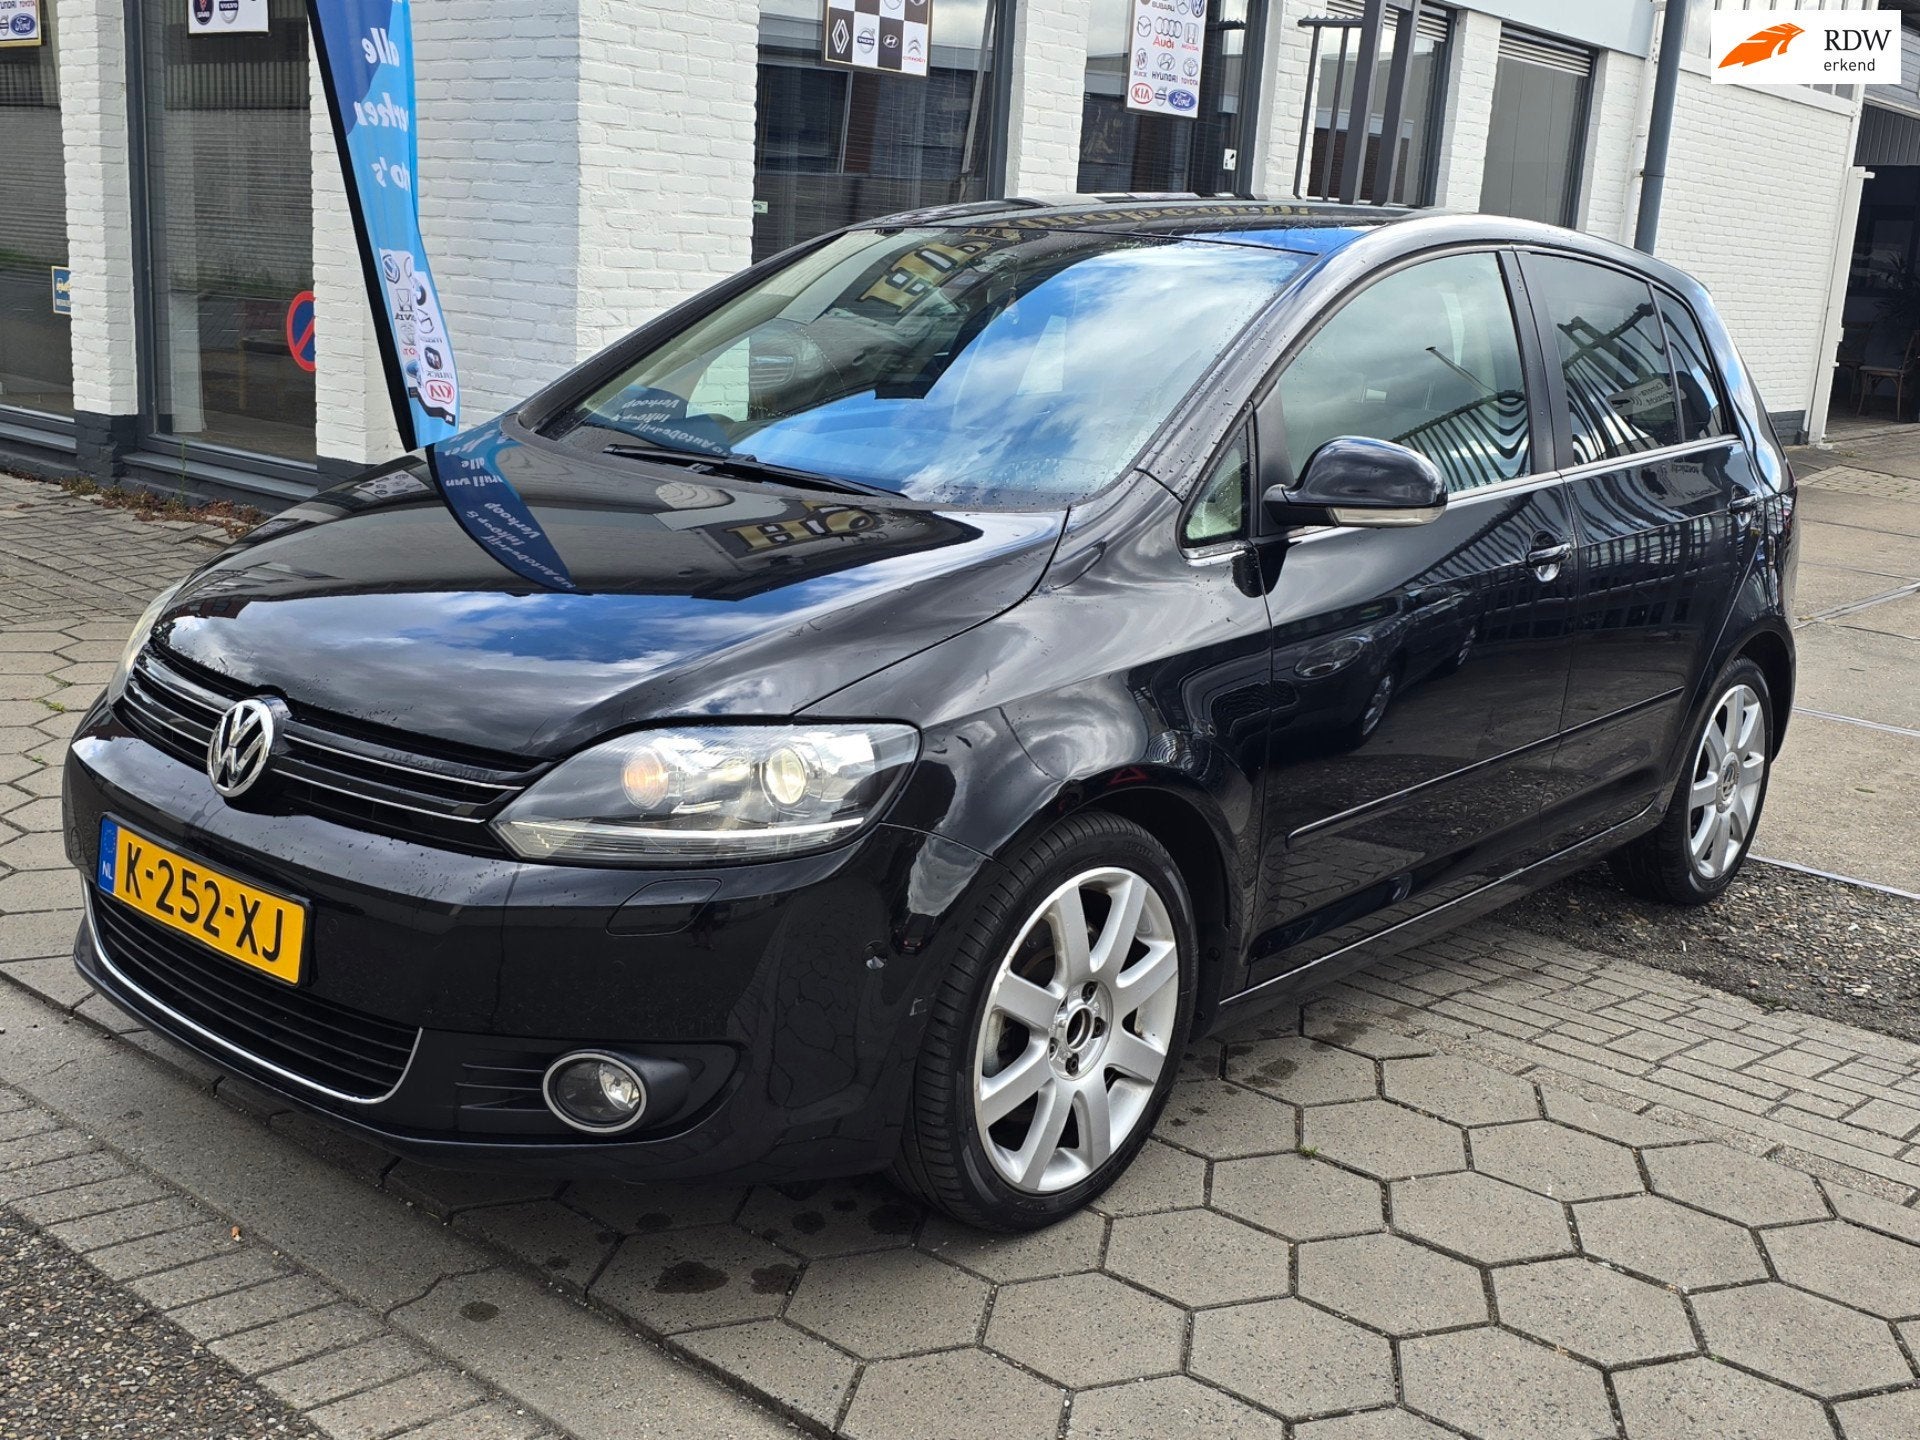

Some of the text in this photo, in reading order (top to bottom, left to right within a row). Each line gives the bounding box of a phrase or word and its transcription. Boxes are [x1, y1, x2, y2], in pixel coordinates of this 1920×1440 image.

[1153, 36, 1175, 50] Audi
[1152, 71, 1179, 83] HYUNDAI
[1134, 86, 1150, 100] KIA
[484, 502, 541, 540] Verkoop
[102, 860, 113, 880] NL
[125, 842, 284, 962] K-252-XJ
